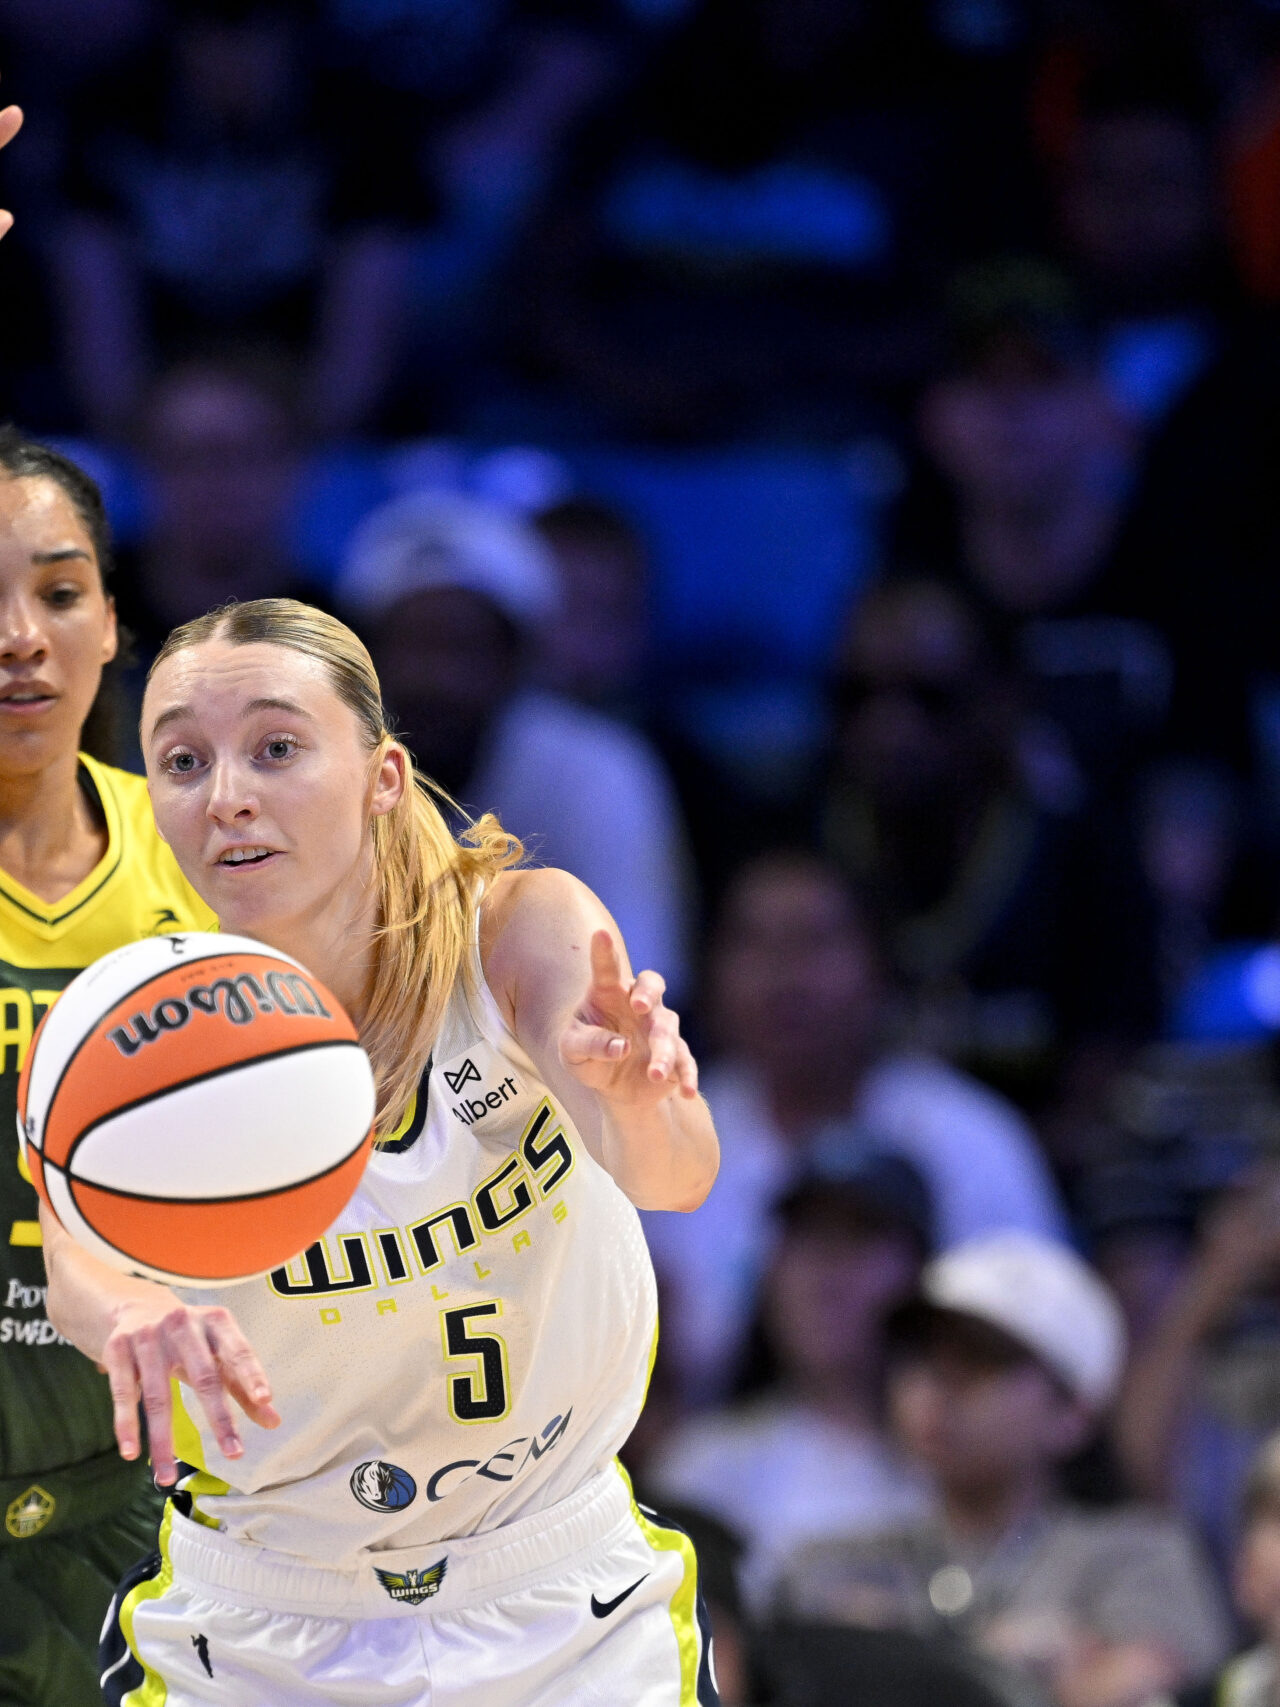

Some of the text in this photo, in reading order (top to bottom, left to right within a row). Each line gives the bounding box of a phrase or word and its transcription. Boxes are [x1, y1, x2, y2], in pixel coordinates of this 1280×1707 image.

[105, 970, 336, 1058] Wilson
[319, 1200, 569, 1326] DALLAS
[439, 1298, 513, 1426] 5
